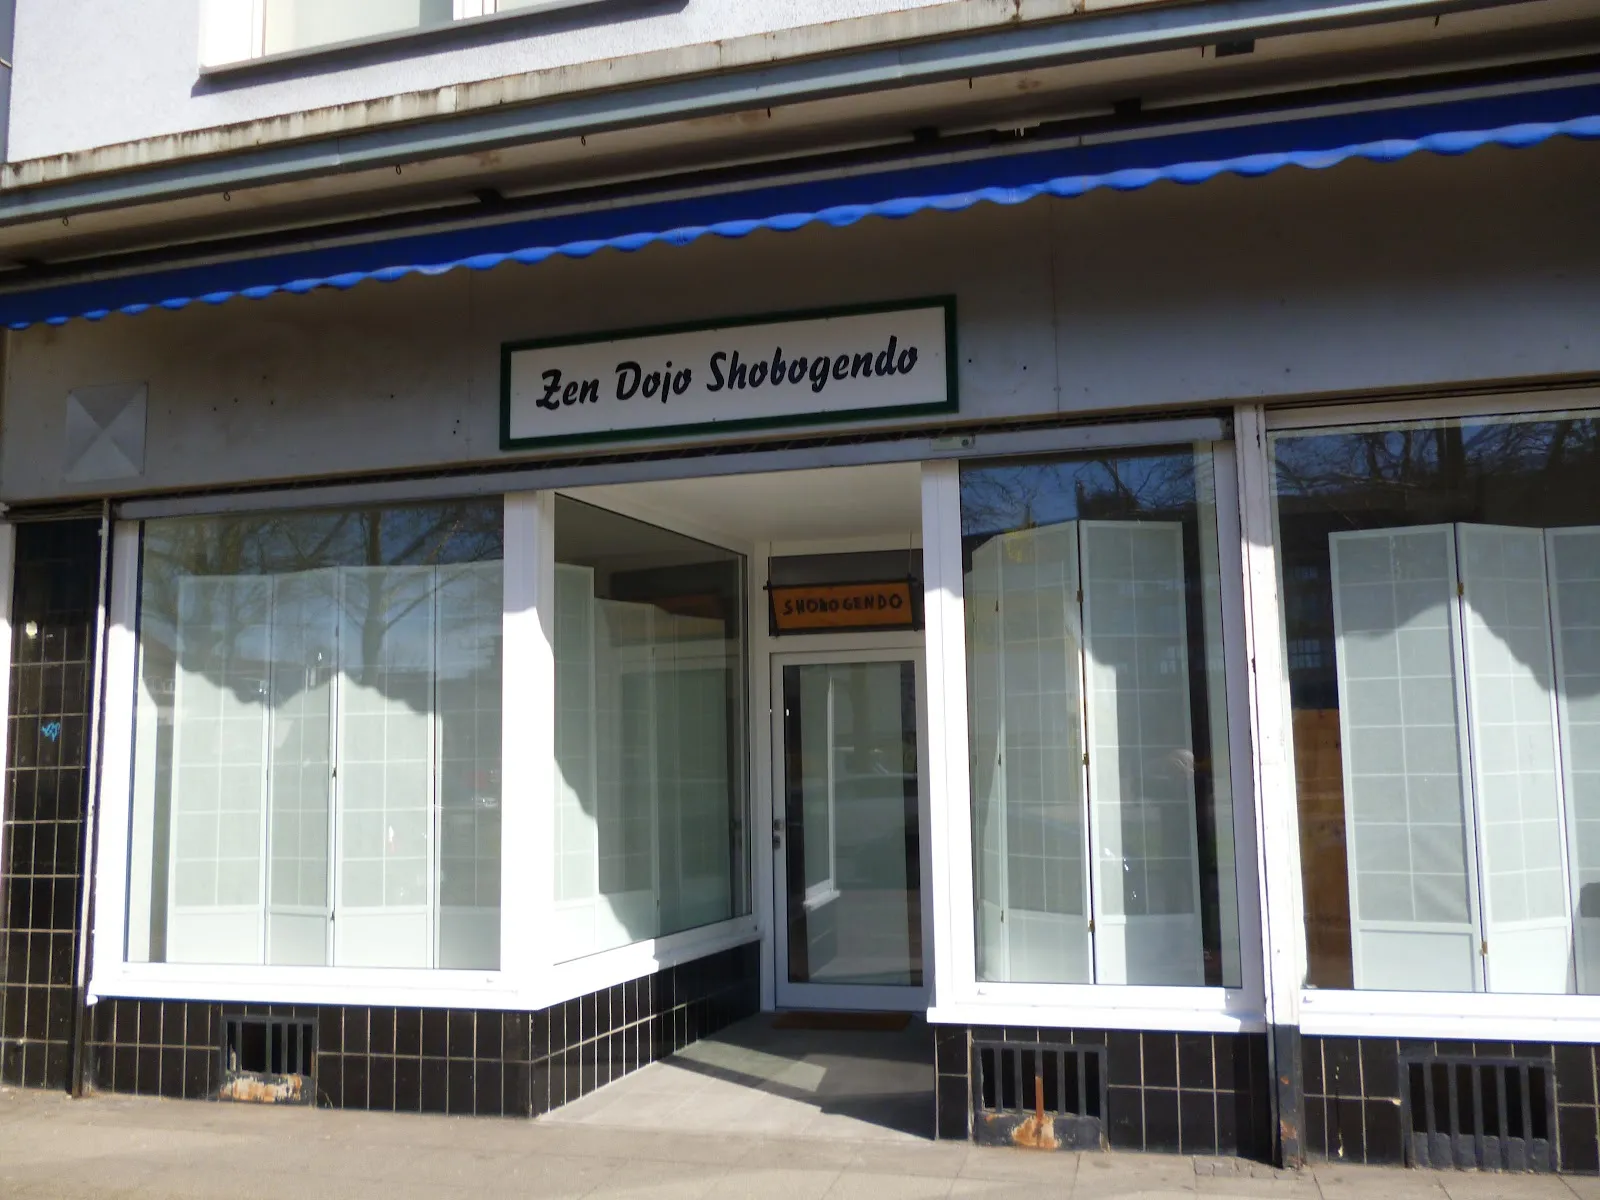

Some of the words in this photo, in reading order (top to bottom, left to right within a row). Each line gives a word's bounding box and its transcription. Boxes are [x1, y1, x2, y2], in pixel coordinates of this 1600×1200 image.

[536, 368, 599, 410] Zen
[615, 361, 692, 404] Dojo
[706, 335, 918, 393] Shobogendo
